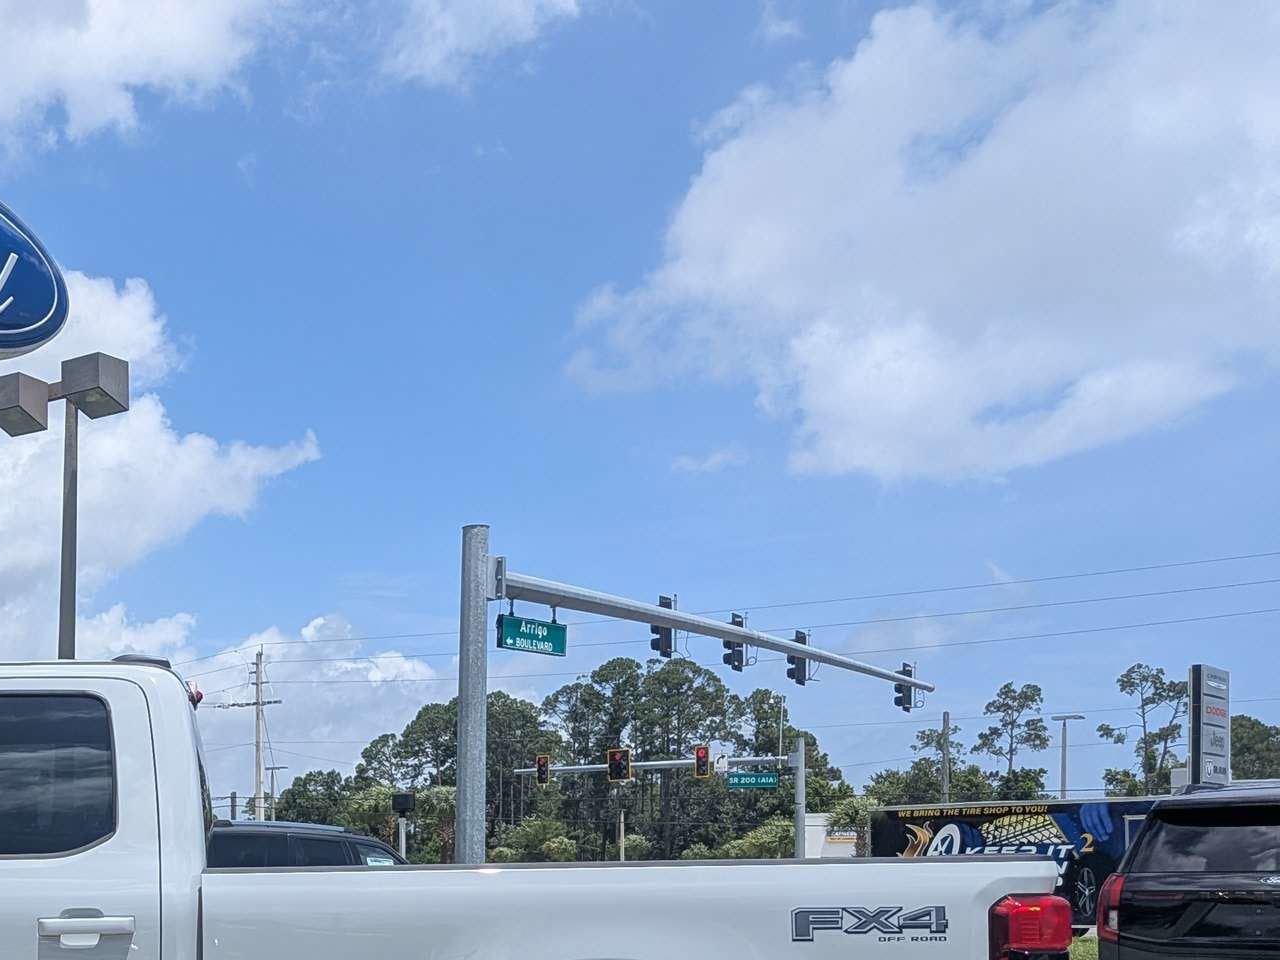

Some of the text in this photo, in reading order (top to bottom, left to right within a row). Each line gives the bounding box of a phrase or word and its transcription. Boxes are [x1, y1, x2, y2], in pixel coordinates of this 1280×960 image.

[519, 620, 548, 639] Arrigo
[515, 637, 553, 652] BOULEVARD
[899, 805, 1048, 818] WE BRING THE TIRE SHOP TO YOU!
[1047, 844, 1075, 858] IT
[1080, 833, 1094, 852] 2
[791, 906, 948, 942] FX4
